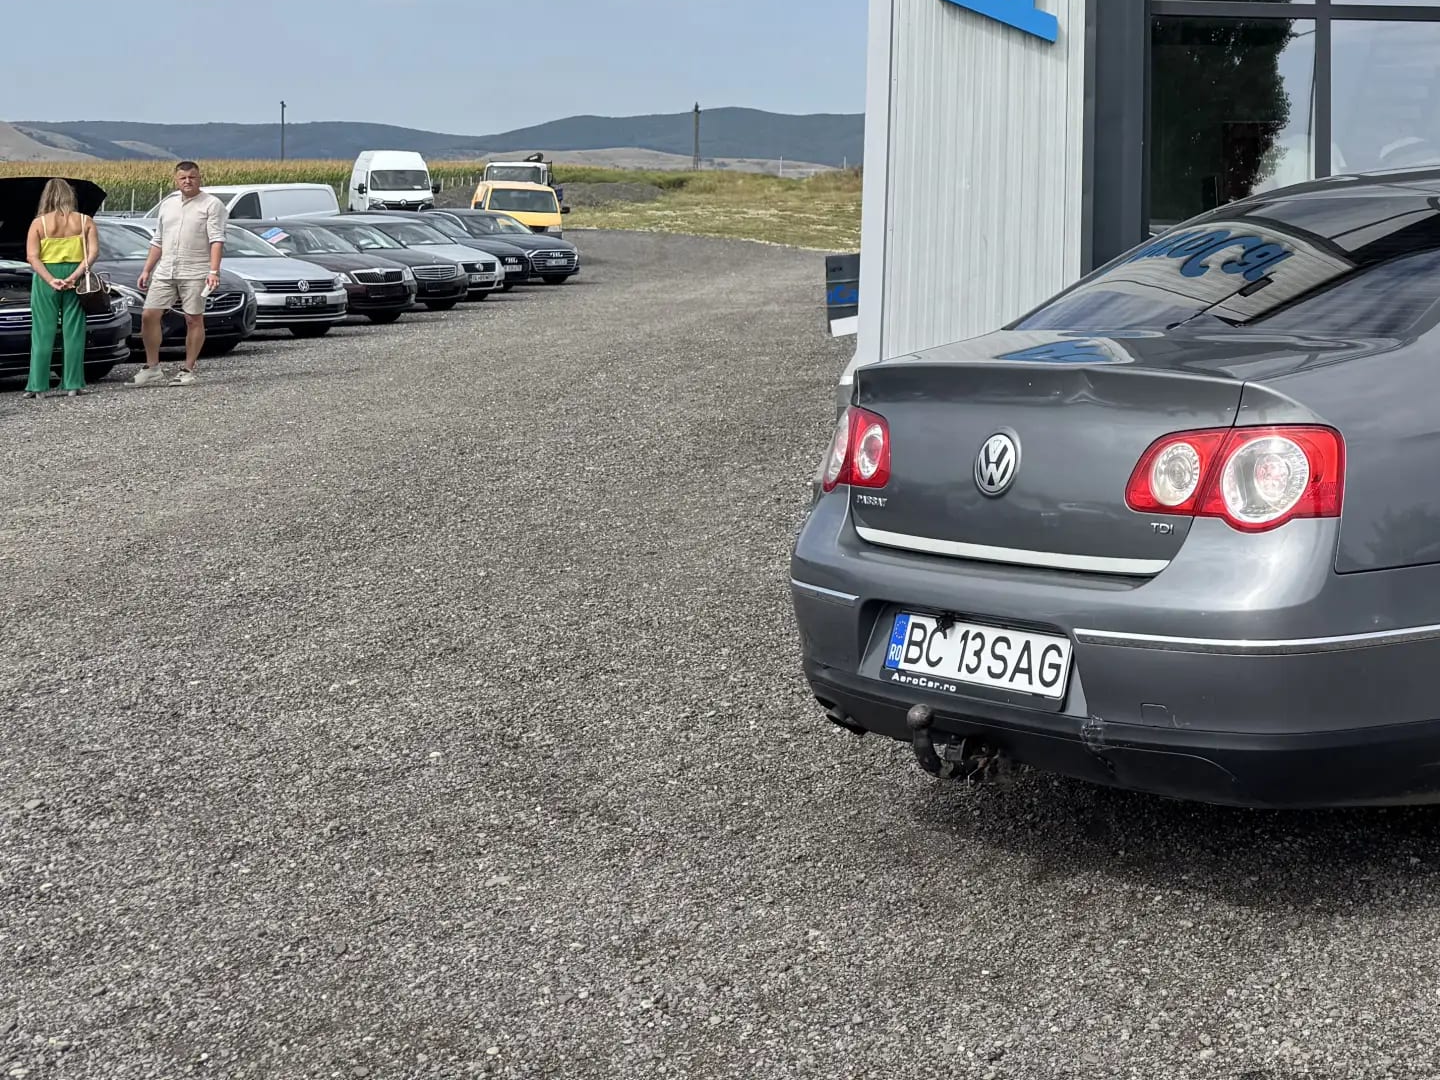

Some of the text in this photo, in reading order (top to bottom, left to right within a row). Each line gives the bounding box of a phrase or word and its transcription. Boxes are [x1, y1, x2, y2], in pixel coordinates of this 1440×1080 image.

[856, 493, 888, 507] PASSAT
[1150, 522, 1175, 535] TDI
[888, 643, 903, 662] RO
[903, 622, 948, 667] BC
[891, 672, 957, 692] AeroCar.ro
